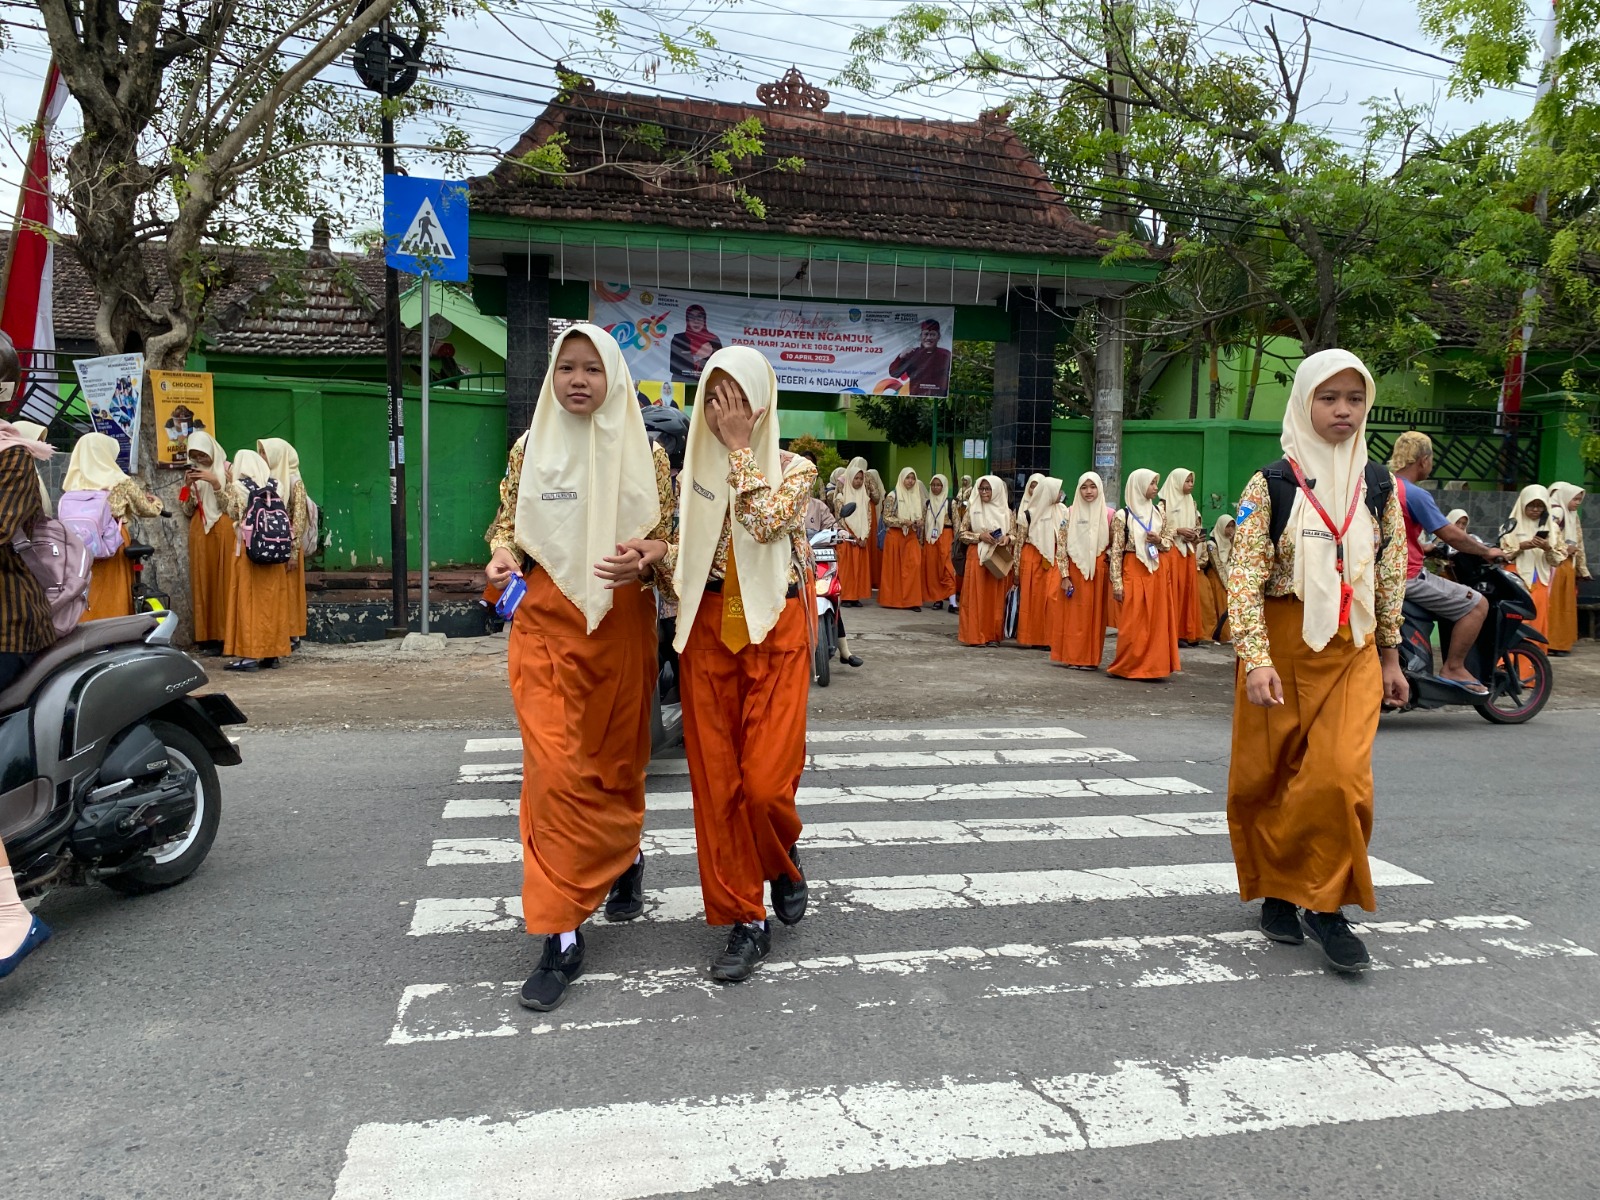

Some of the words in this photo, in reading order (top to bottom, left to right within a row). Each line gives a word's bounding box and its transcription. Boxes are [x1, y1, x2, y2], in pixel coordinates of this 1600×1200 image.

[743, 326, 815, 340] KABUPATEN
[817, 331, 873, 344] NGANJUK
[731, 338, 756, 346] PADA
[757, 339, 778, 348] HARI
[780, 341, 800, 349] JADI
[814, 343, 833, 352] 1086
[835, 345, 863, 353] TAHUN
[864, 346, 884, 354] 2023
[775, 375, 807, 385] NEGERI
[809, 378, 815, 386] 4
[817, 378, 859, 388] NGANJUK
